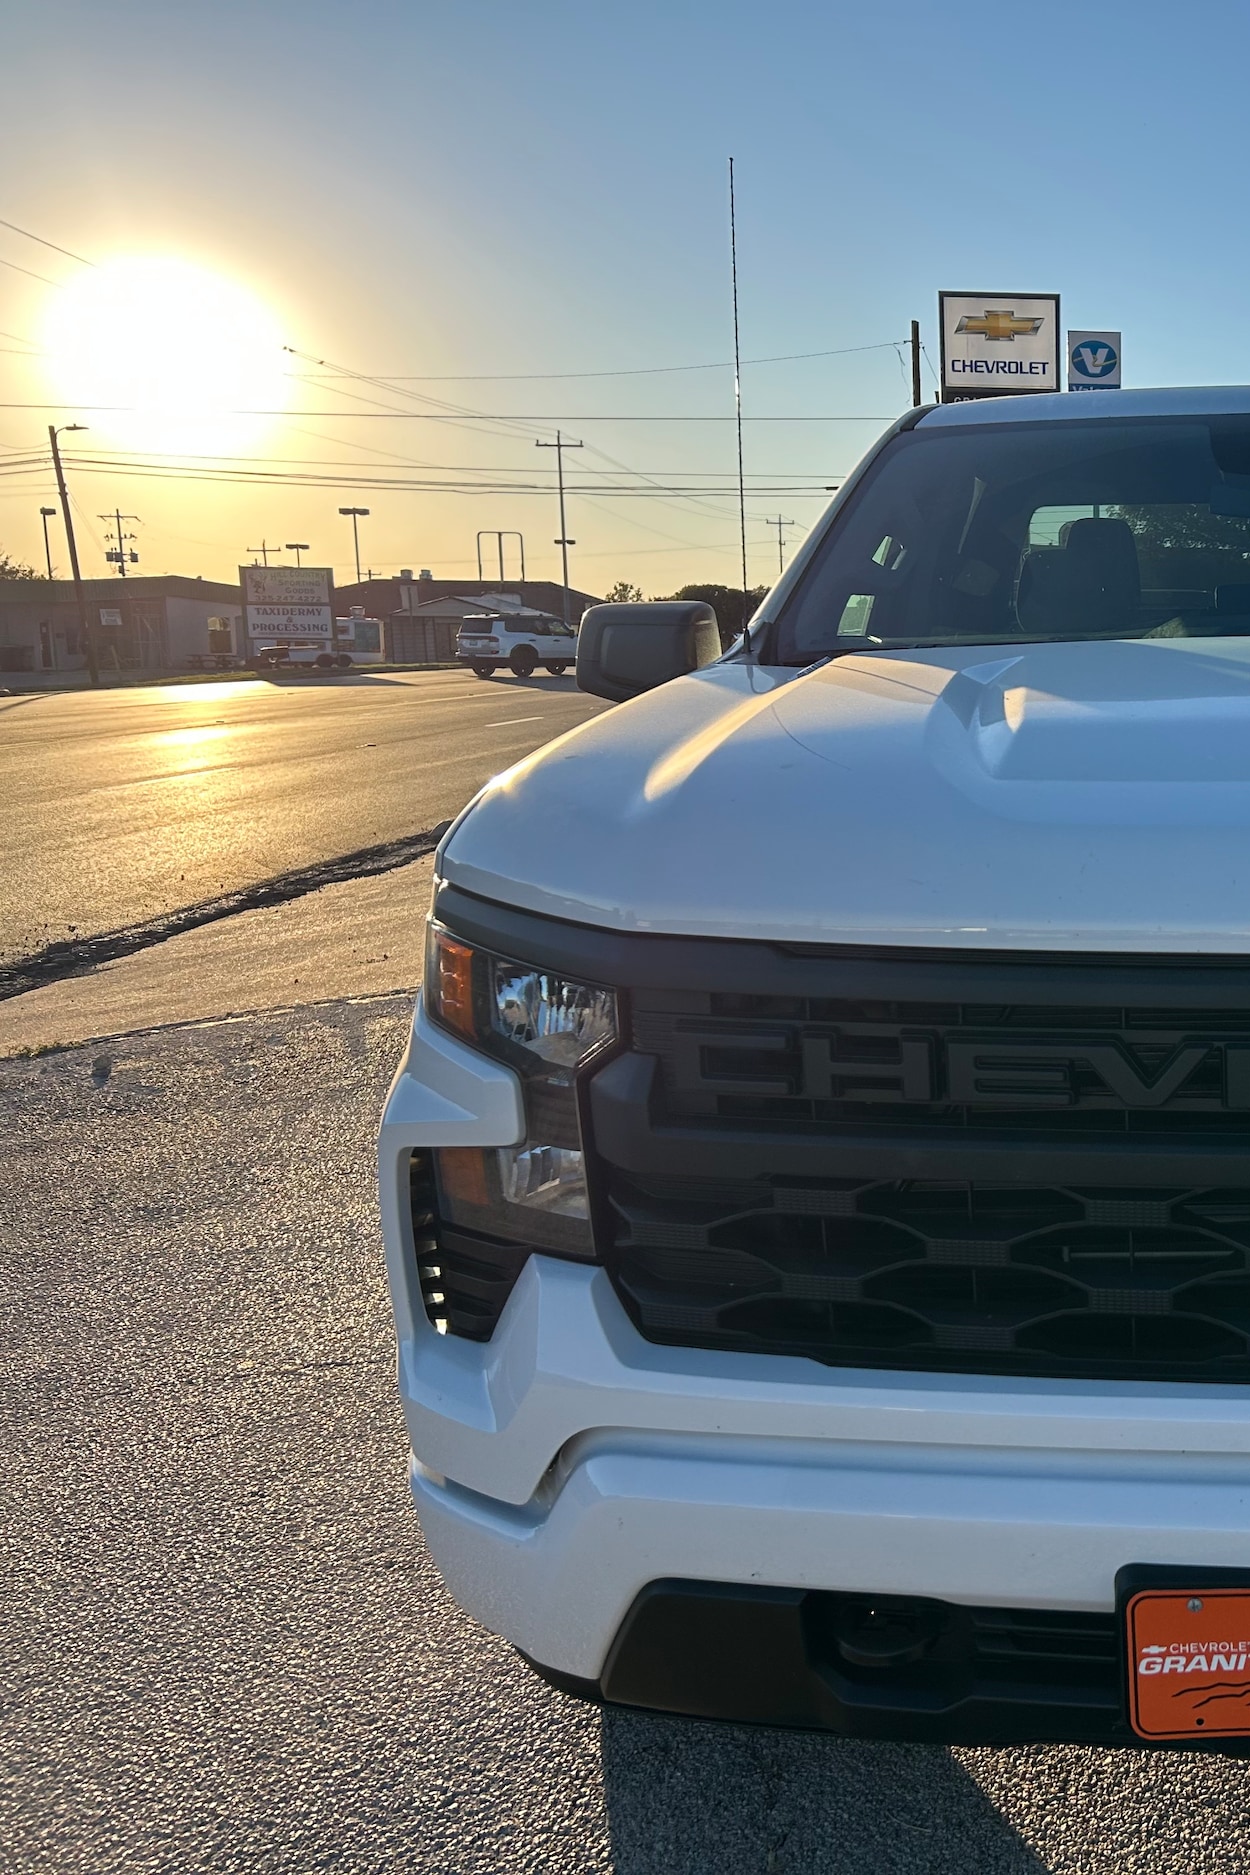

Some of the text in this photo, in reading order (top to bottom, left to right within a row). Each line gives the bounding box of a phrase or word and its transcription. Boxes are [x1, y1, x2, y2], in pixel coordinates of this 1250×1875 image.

[951, 359, 1049, 375] CHEVROLET
[270, 570, 326, 583] HILL COUNTRY
[254, 607, 322, 616] TAXIDERMY
[252, 623, 328, 632] PROCESSING
